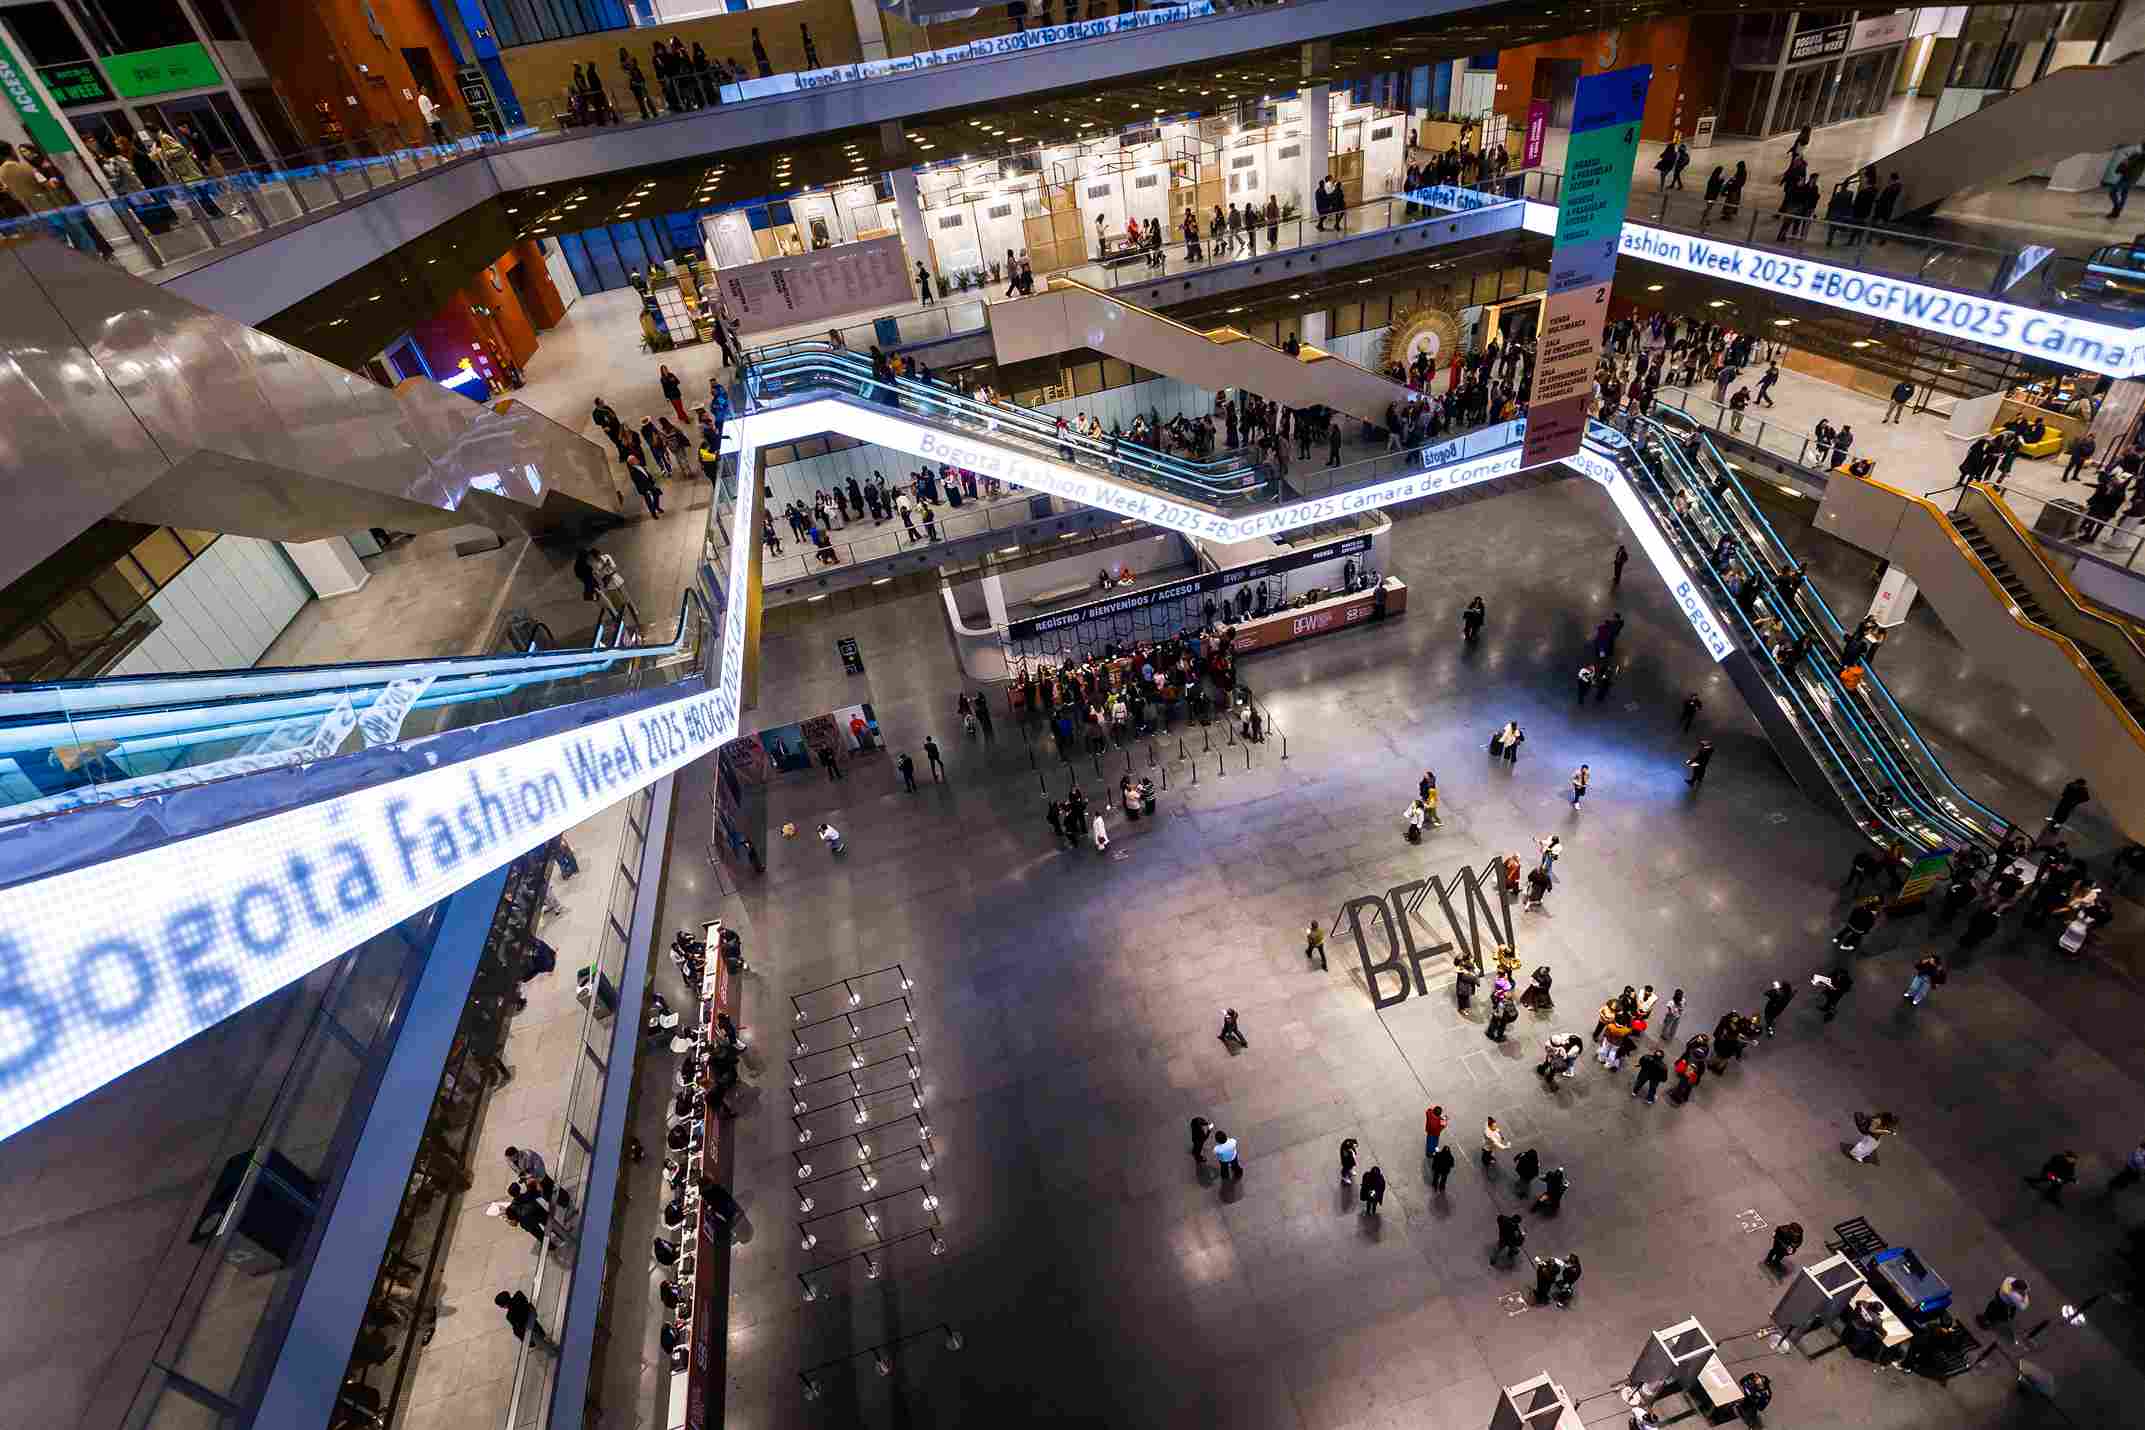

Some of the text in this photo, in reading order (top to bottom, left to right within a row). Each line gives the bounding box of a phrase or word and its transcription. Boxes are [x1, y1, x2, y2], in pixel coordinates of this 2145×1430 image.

[1623, 127, 1635, 145] 4
[1595, 288, 1605, 304] 2
[1688, 241, 1743, 276] Week
[1750, 255, 1804, 290] 2025
[1810, 268, 2010, 338] #BOGFW2025
[1095, 484, 1150, 521] Week
[1155, 502, 1200, 532] 2025
[1419, 473, 1443, 493] de
[1158, 585, 1193, 601] ACCESO
[382, 766, 569, 885] Fashion
[562, 717, 644, 803] Week
[639, 706, 687, 770] 2025
[1345, 855, 1516, 1011] BFW
